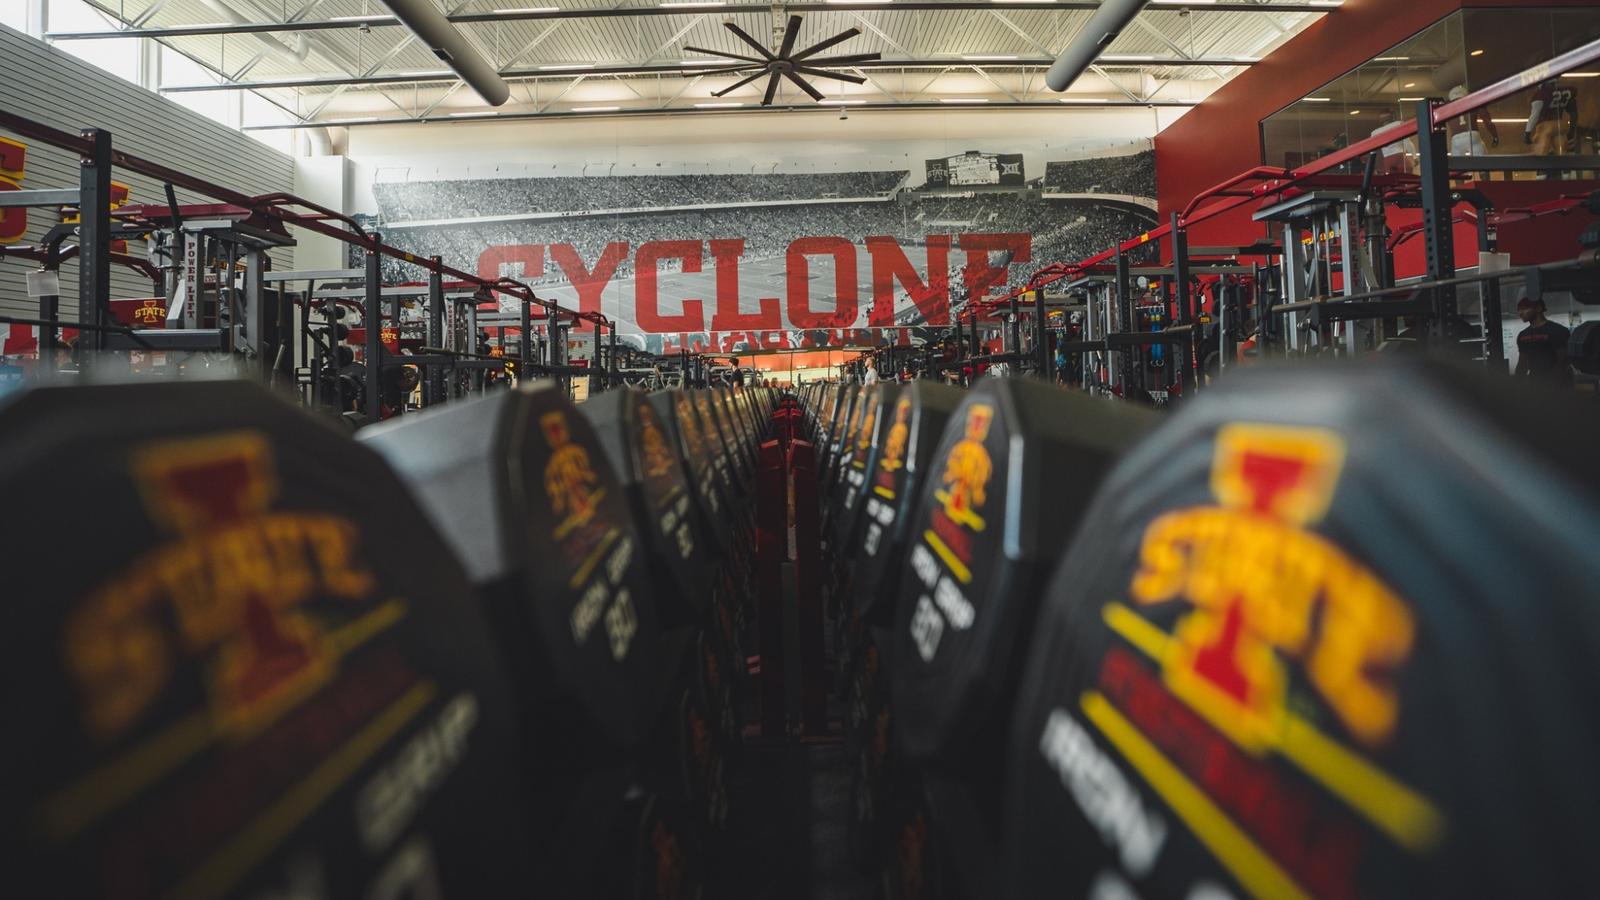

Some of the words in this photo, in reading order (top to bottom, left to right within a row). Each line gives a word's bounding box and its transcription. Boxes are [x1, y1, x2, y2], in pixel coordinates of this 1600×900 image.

[187, 242, 196, 282] POWER
[135, 306, 166, 318] STATE
[187, 286, 196, 318] LIFT
[1130, 503, 1415, 747] STATE
